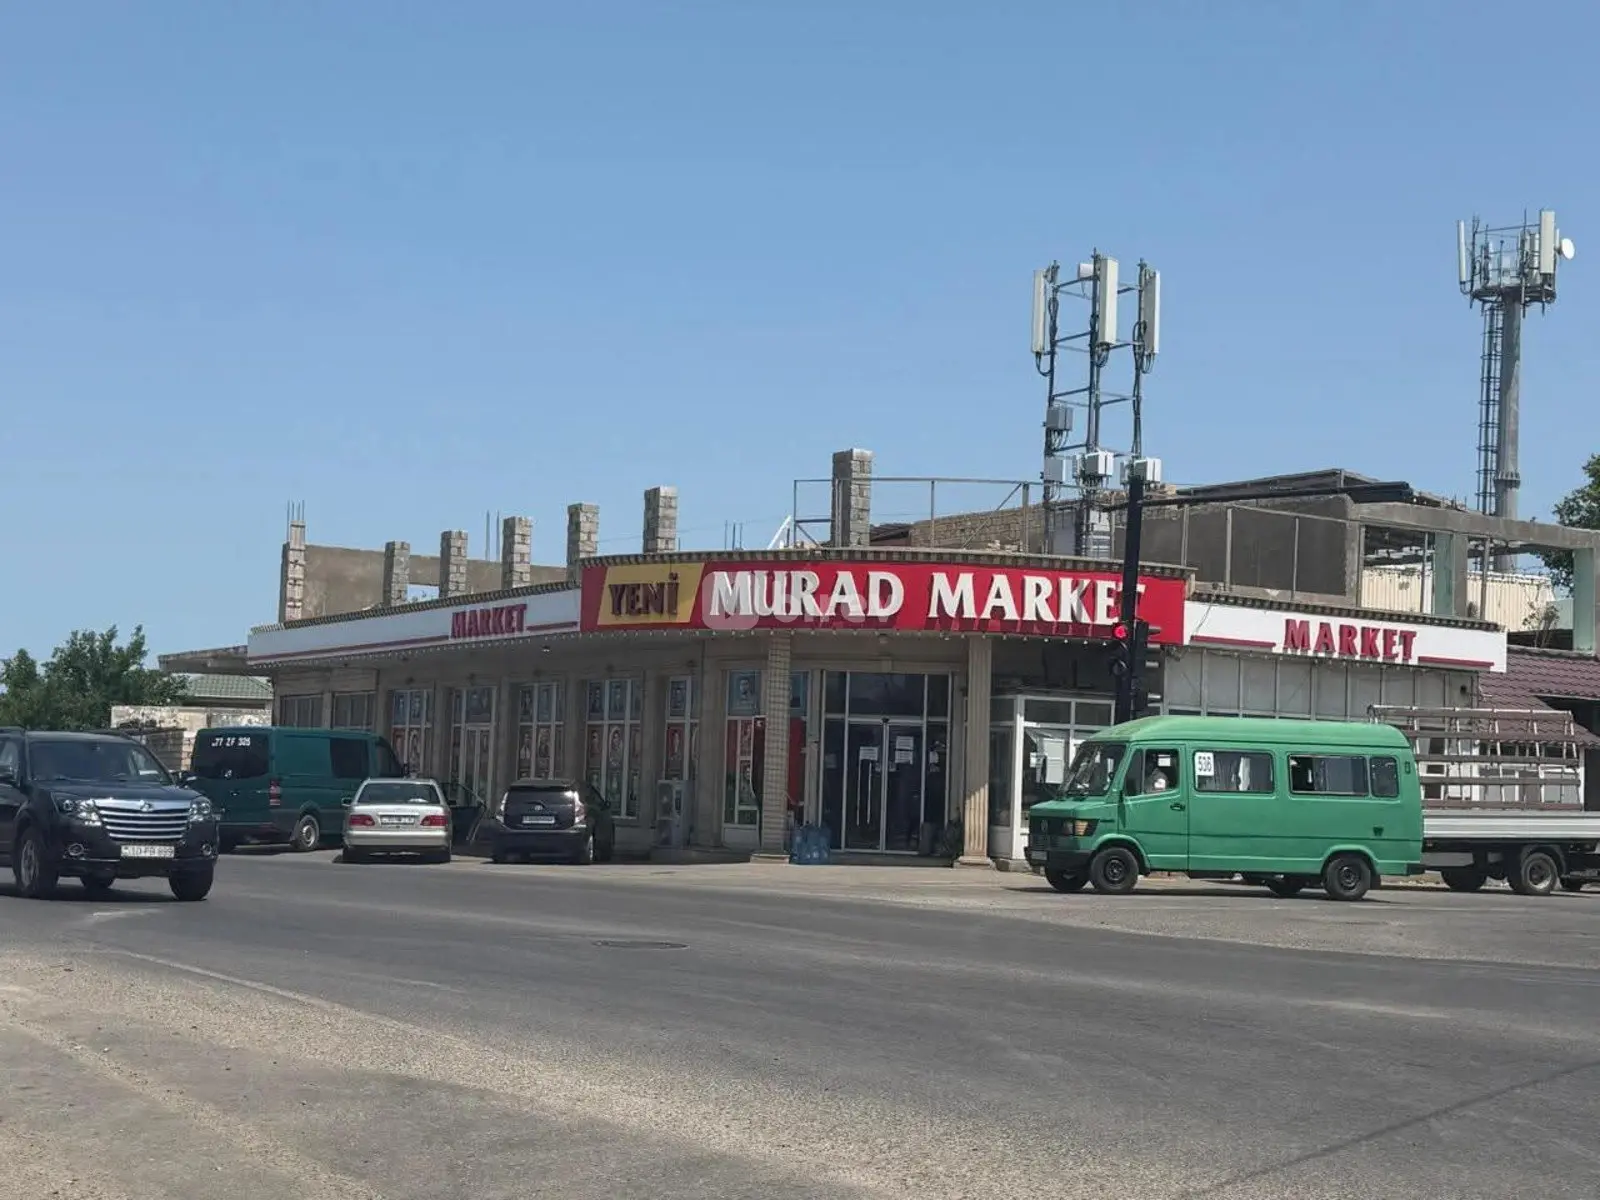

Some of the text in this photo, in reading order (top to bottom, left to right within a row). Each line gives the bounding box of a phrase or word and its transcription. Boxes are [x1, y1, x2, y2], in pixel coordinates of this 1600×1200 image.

[608, 570, 1146, 627] YENİ MURAD MARKE
[450, 603, 528, 638] MARKET
[1282, 618, 1418, 661] MARKET
